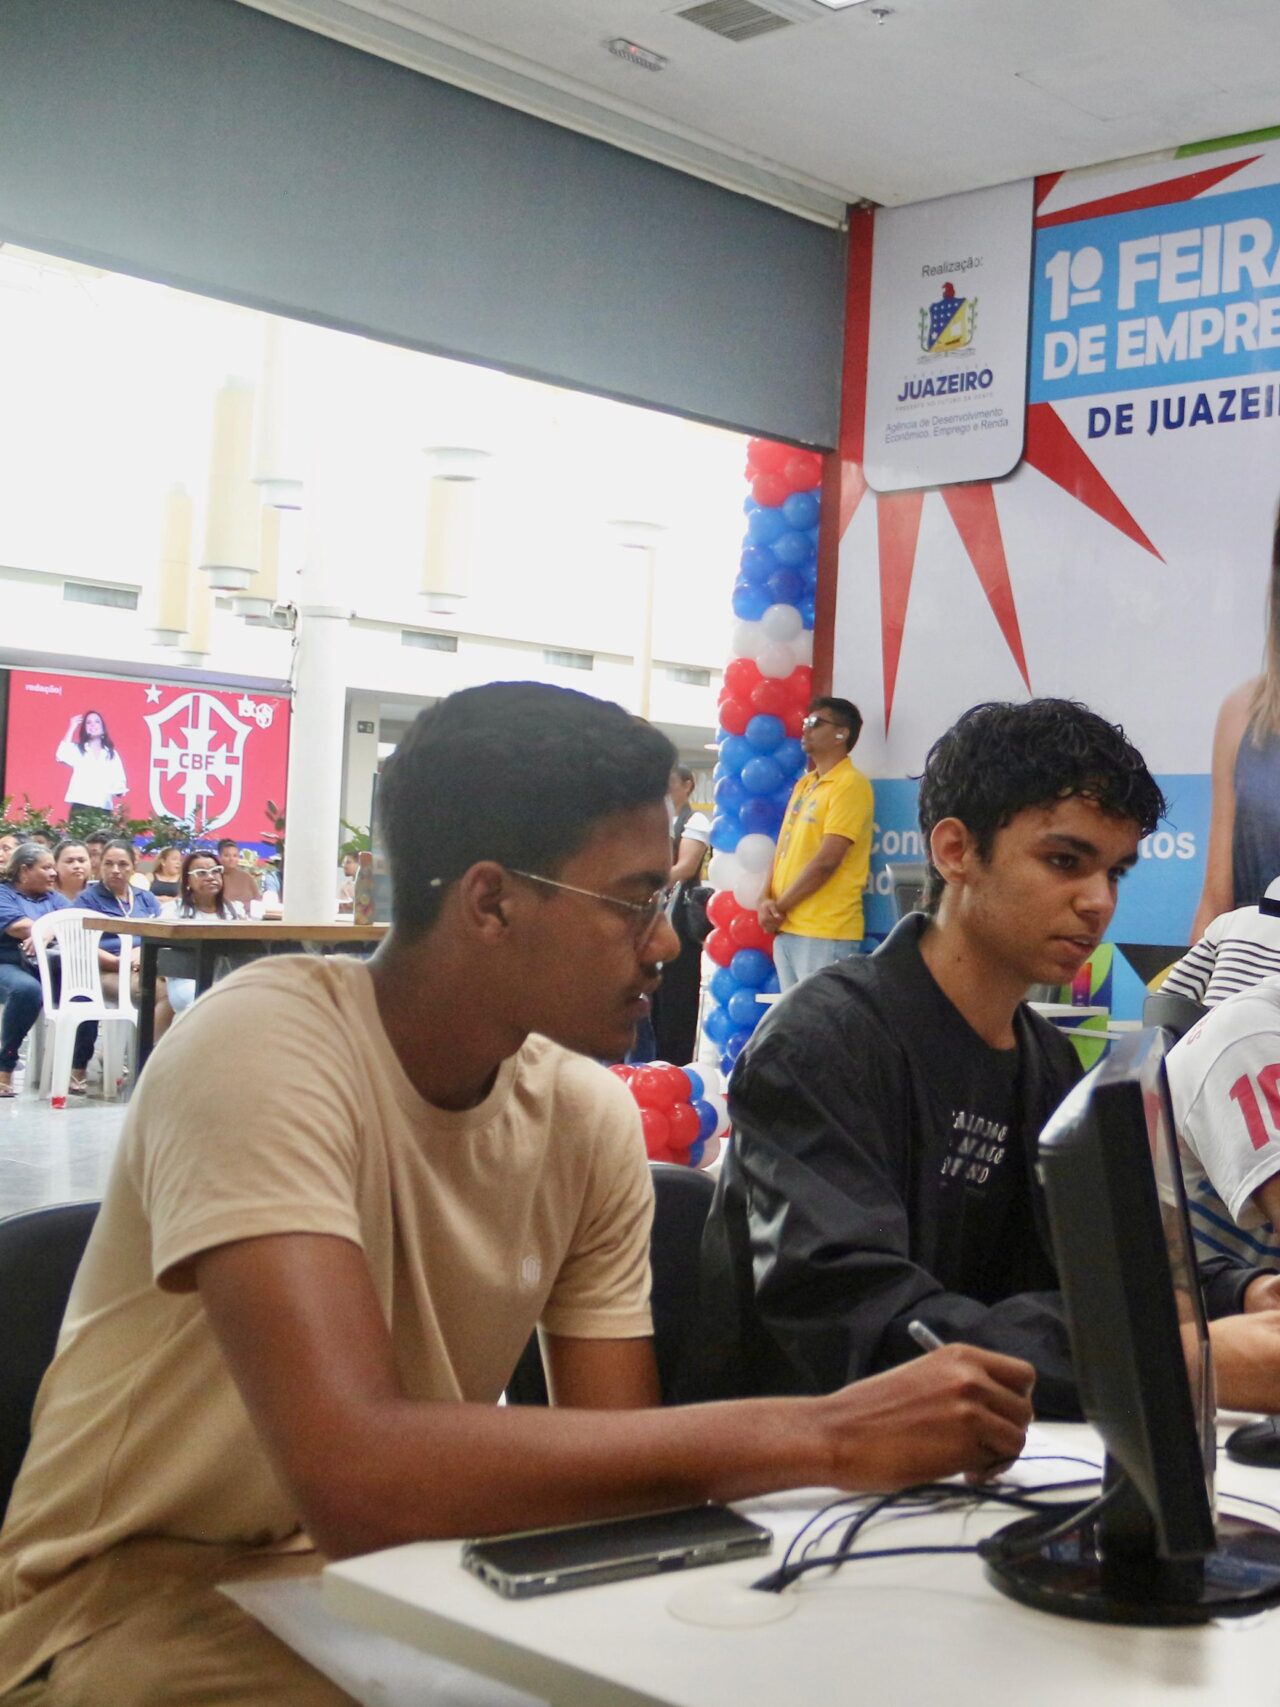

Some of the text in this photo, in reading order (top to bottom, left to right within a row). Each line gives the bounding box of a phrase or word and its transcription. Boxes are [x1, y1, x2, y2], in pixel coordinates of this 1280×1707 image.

[921, 256, 984, 278] Realização:
[1043, 324, 1107, 381] DE
[897, 368, 994, 402] JUAZEIRO
[919, 417, 931, 428] de
[932, 408, 1004, 426] Desenvolvimento
[981, 418, 1009, 430] Renda
[1087, 402, 1134, 439] DE
[178, 753, 216, 770] CBF
